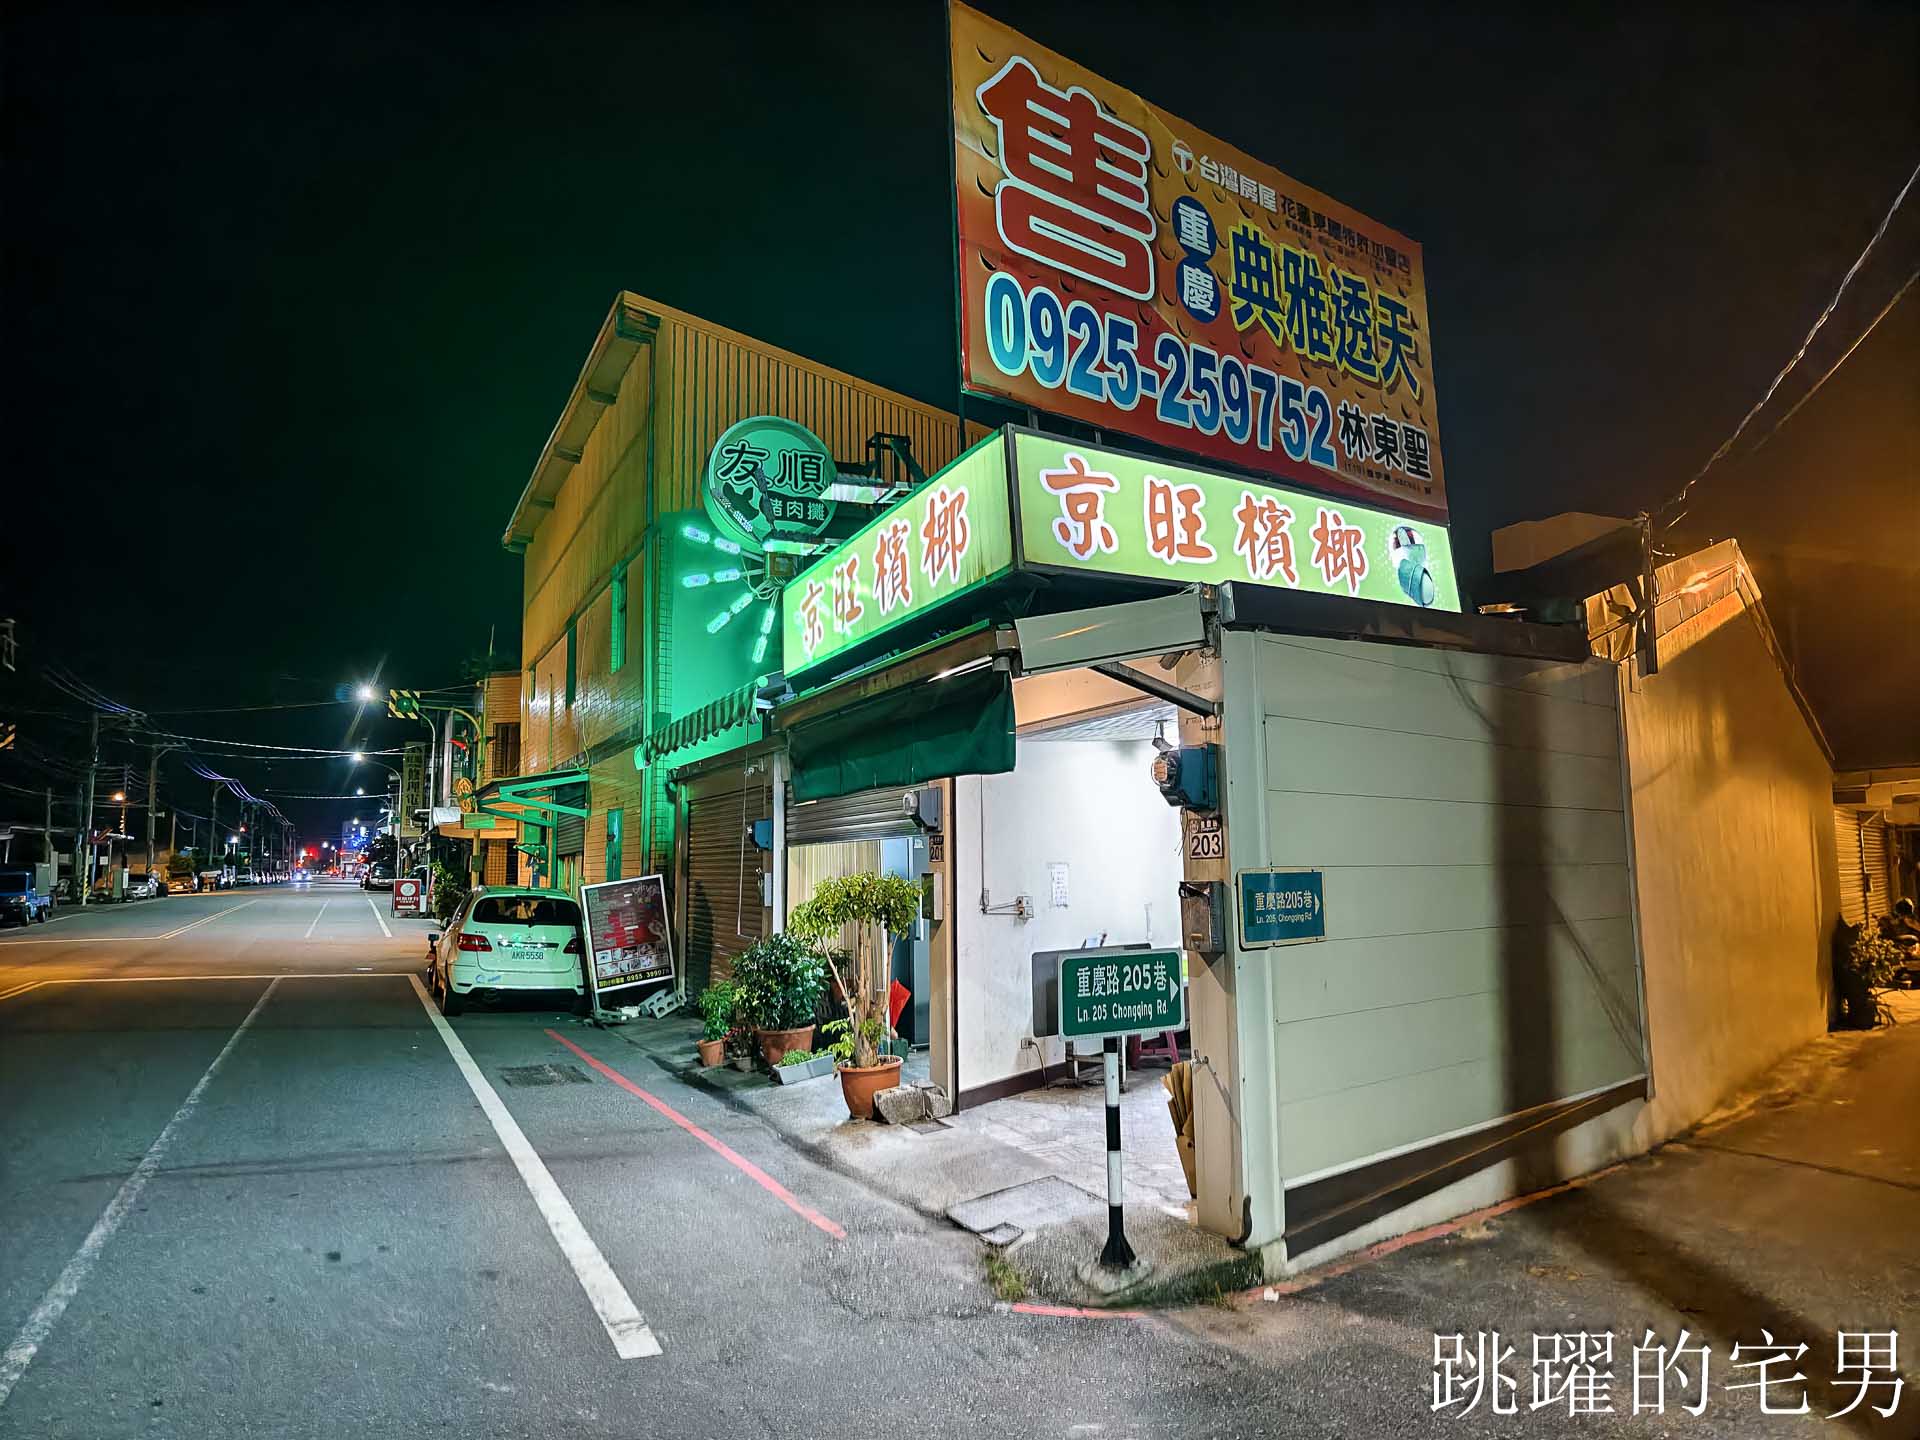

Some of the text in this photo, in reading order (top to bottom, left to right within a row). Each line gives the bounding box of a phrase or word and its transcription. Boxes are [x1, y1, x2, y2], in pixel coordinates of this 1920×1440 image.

[976, 55, 1156, 301] 售
[1199, 155, 1278, 213] 台灣房屋
[1178, 200, 1217, 318] 重慶
[1228, 221, 1421, 400] 典雅透天
[985, 270, 1338, 469] 0925-259752
[716, 439, 827, 496] 友順
[1337, 402, 1432, 481] 林東聖
[1038, 452, 1370, 596] 京旺檳榔
[800, 484, 969, 653] 京旺檳榔
[929, 845, 943, 862] 201
[1191, 834, 1222, 857] 203
[1255, 889, 1313, 911] 重慶路205巷
[1092, 1004, 1107, 1021] 205
[1112, 1001, 1153, 1022] Chongqing
